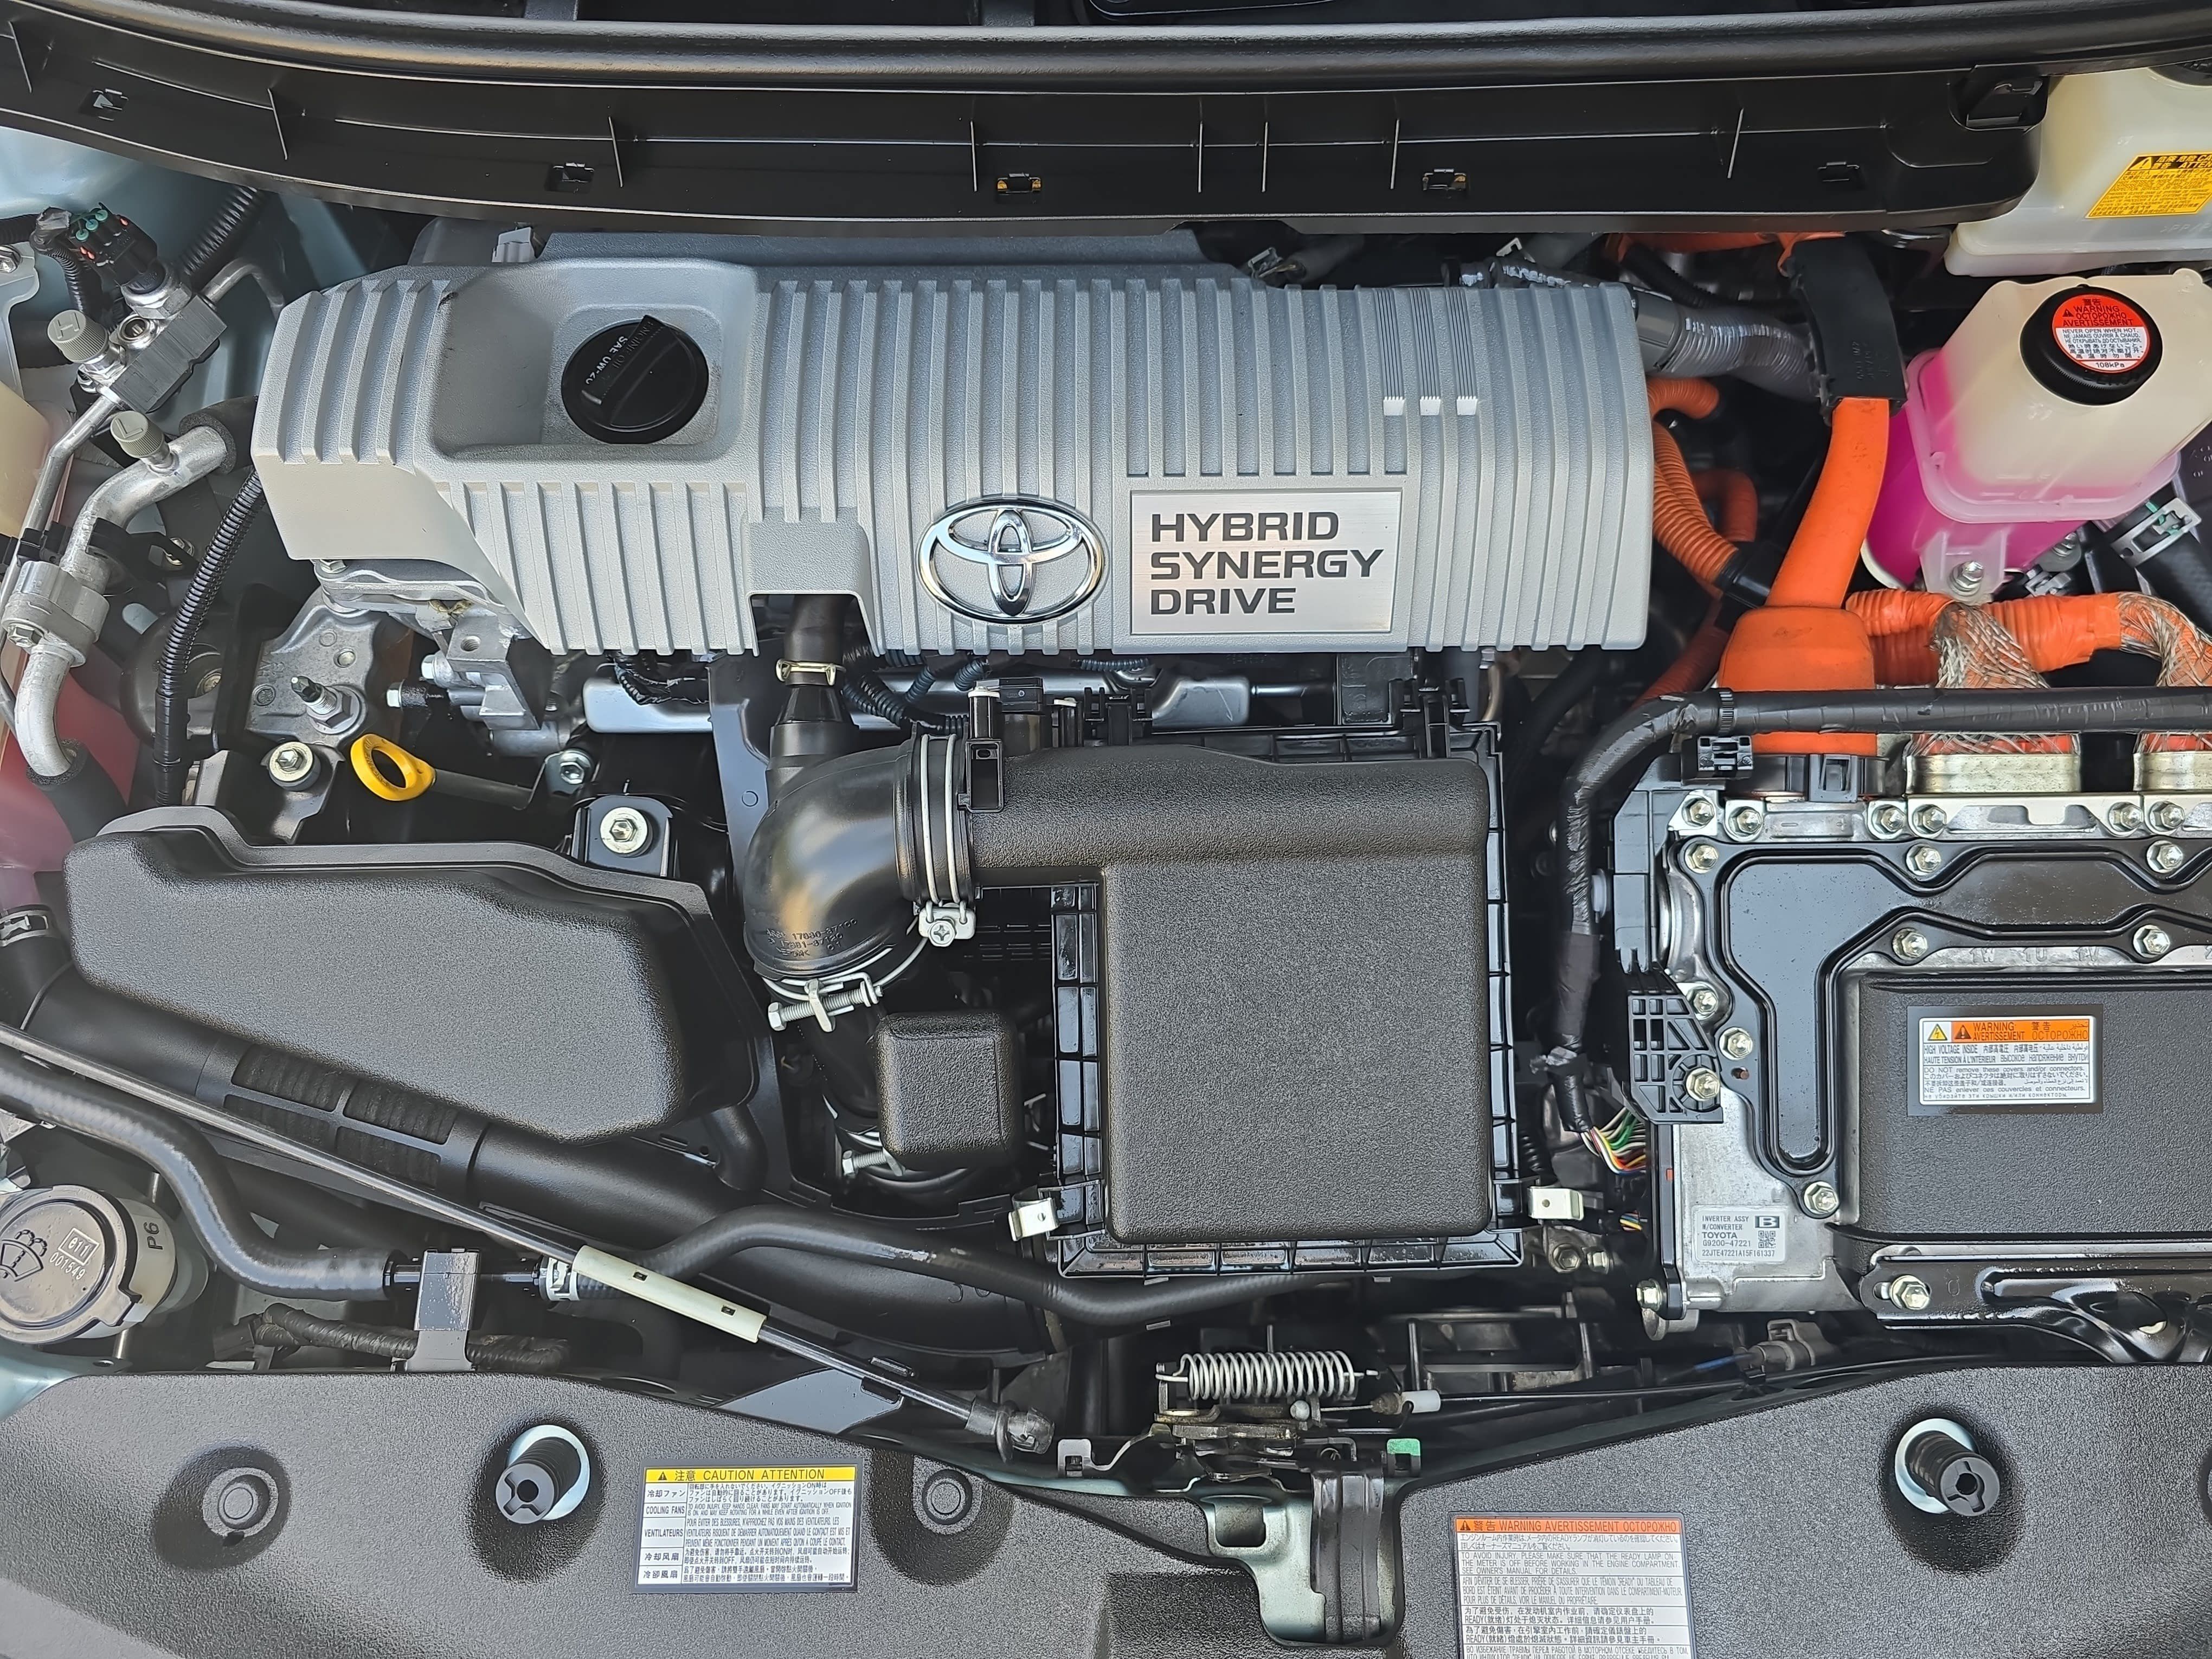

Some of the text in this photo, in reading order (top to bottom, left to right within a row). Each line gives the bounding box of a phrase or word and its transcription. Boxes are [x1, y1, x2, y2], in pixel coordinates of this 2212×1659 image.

[2073, 305, 2119, 313] WARNING
[2063, 319, 2133, 327] AVERTISSEMENT
[609, 336, 628, 353] SAE
[1152, 512, 1339, 542] HYBRID
[1151, 549, 1384, 580] SYNERGY
[1151, 587, 1296, 615] DRIVE
[1973, 1021, 2015, 1031] WARNING
[2031, 1021, 2051, 1030] 警告
[1973, 1031, 2025, 1041] AVERTISSEMENT
[2031, 1030, 2088, 1040] ОСТОРОЖНО
[1924, 1044, 1978, 1054] HIGH VOLTAGE INSIDE
[1962, 1054, 1966, 1063] À
[1759, 1216, 1777, 1227] B
[143, 1222, 163, 1250] P6
[68, 1237, 91, 1257] e11
[49, 1252, 86, 1280] 001549
[674, 1469, 825, 1481] 注意 CAUTION ATTENTION
[646, 1506, 685, 1514] COOLING FANS
[1474, 1520, 1676, 1532] 警告 WARNING AVERTISSEMENT ОСТОРОЖНО
[645, 1528, 683, 1537] VENTILATEURS
[645, 1552, 679, 1561] 冷却风扇
